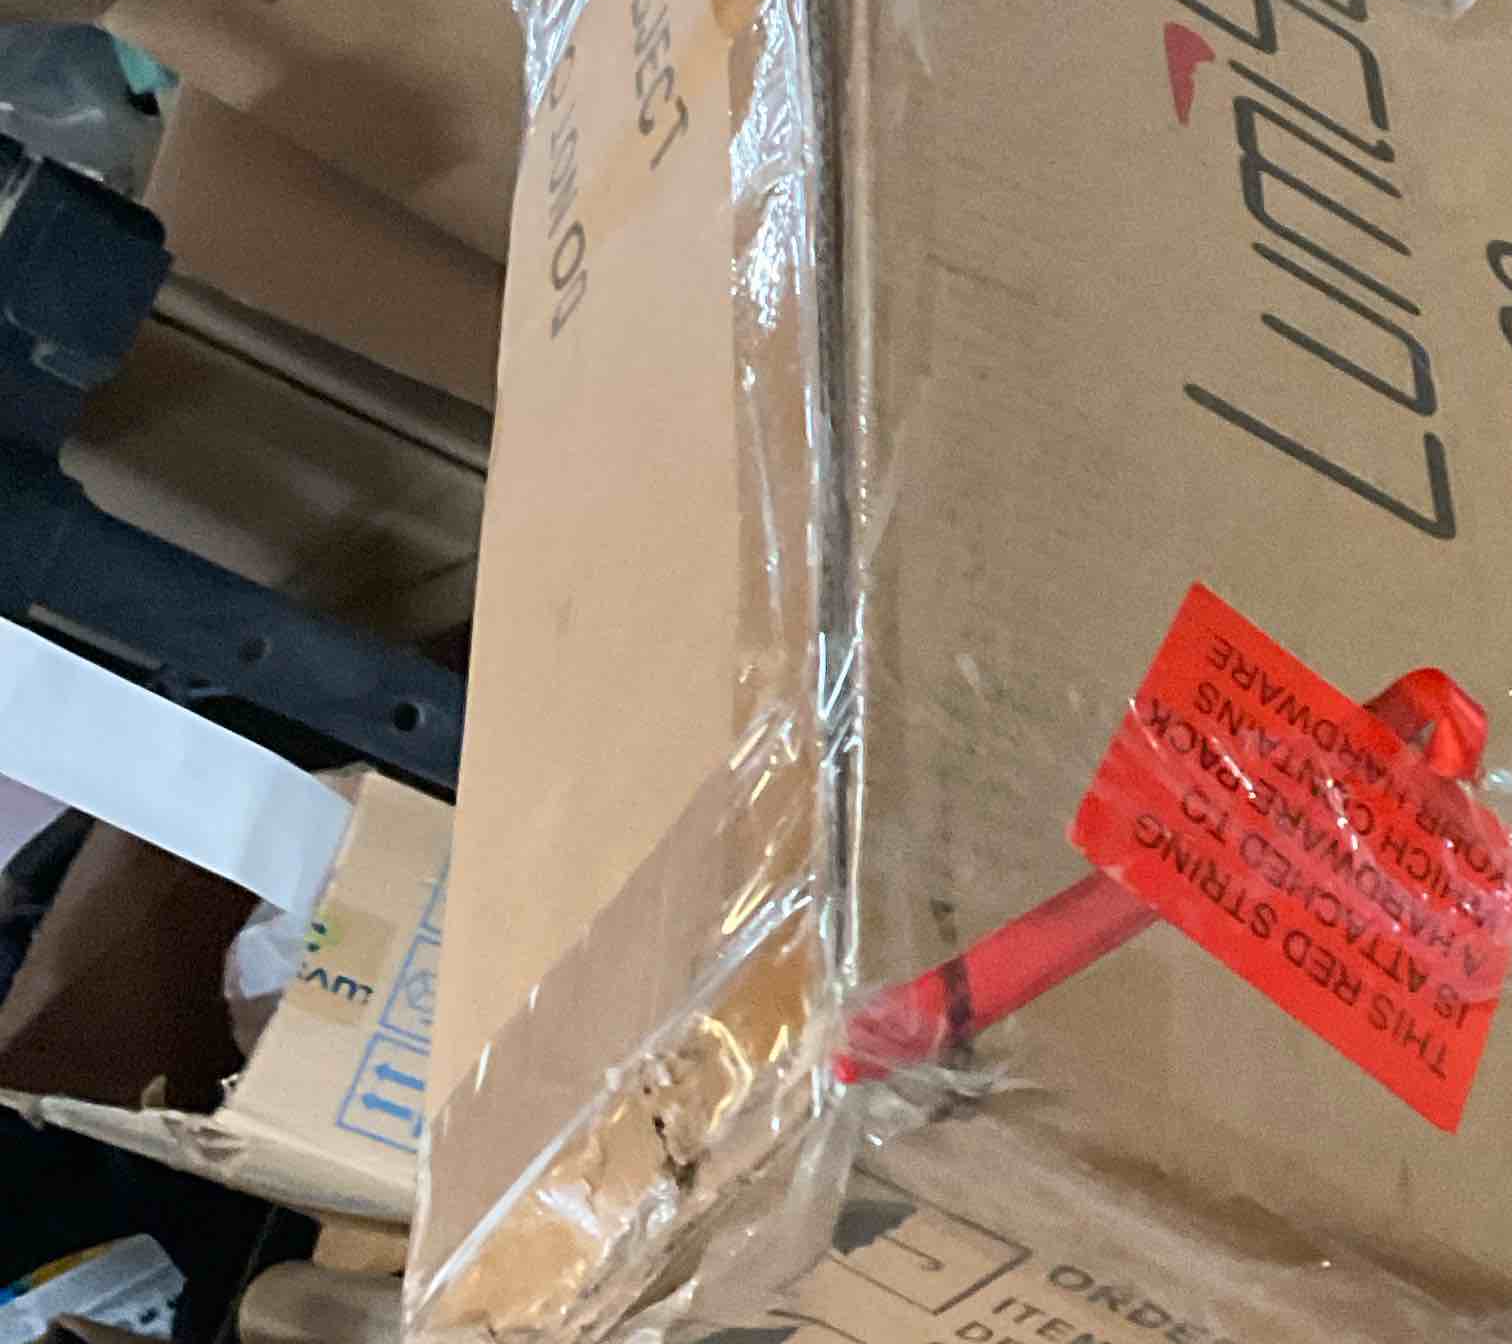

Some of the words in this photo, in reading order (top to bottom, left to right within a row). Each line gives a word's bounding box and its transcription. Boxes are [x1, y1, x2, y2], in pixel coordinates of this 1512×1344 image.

[1141, 697, 1249, 797] PACK
[1180, 787, 1232, 845] TO
[1133, 812, 1280, 940] STRING
[1239, 831, 1428, 996] ATTACHED
[1281, 929, 1364, 1007] RED
[1432, 981, 1471, 1030] IS
[1366, 990, 1448, 1081] THIS
